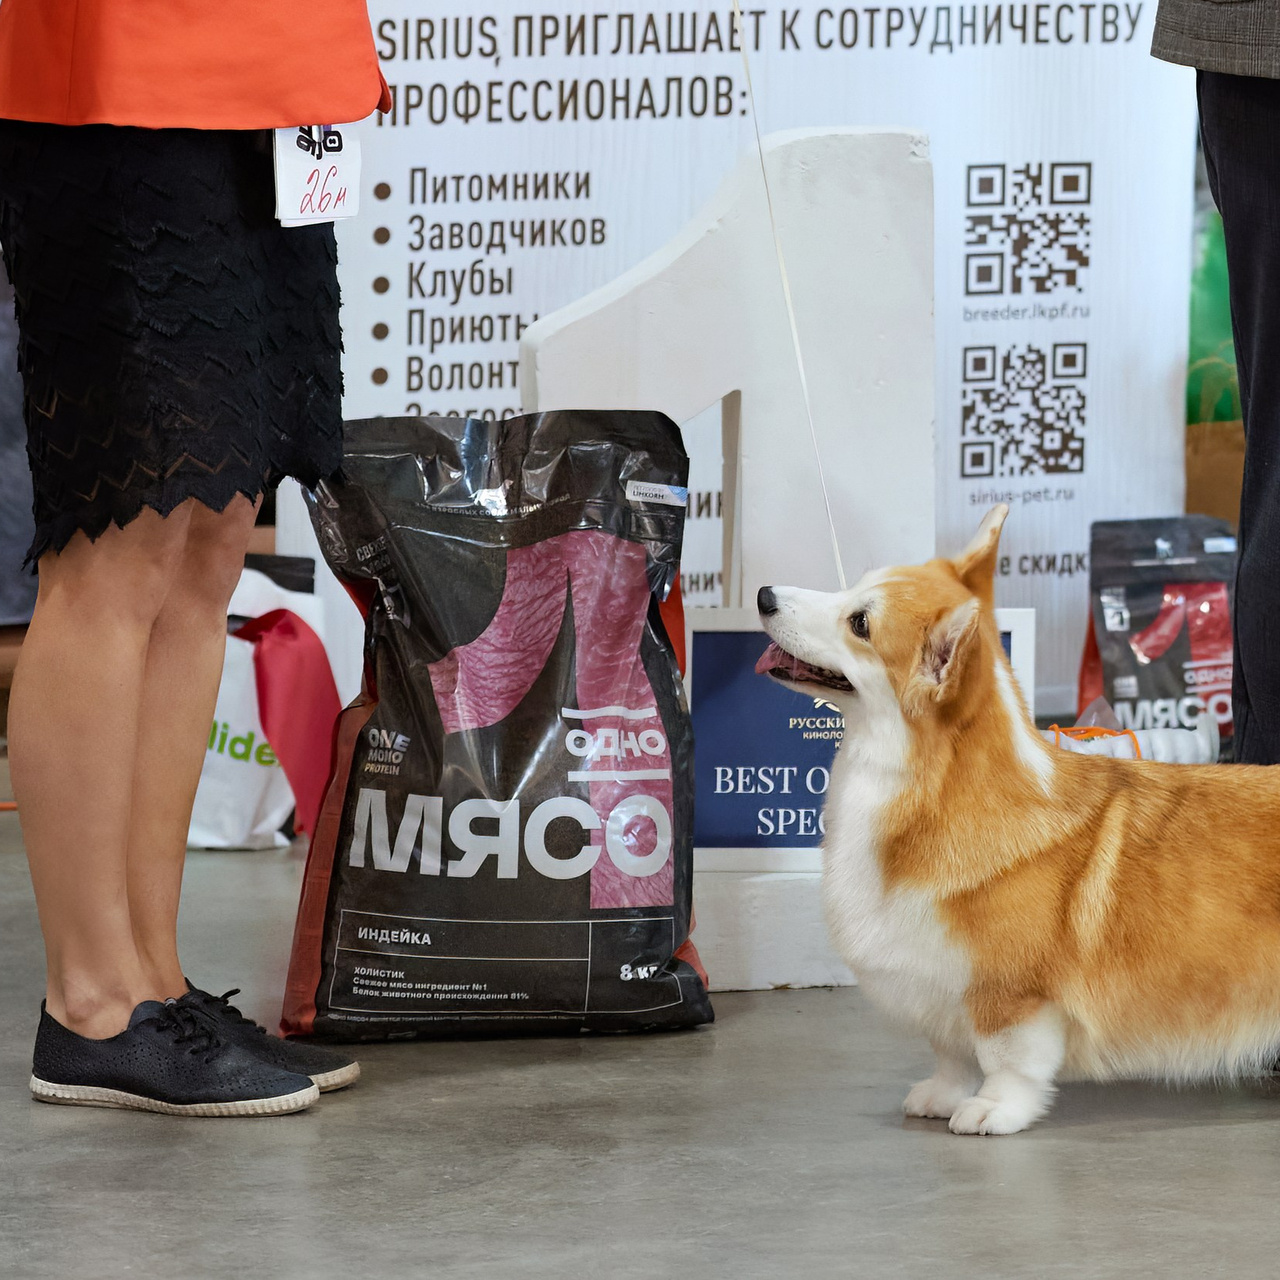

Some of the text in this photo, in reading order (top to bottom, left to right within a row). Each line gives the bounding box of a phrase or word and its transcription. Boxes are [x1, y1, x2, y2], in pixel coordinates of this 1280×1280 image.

[514, 9, 768, 57] ПРИГЛАШАЕТ
[780, 9, 800, 50] К
[815, 2, 1144, 55] СОТРУДНИЧЕСТВУ
[377, 75, 749, 127] ПРОФЕССИОНАЛОВ:
[409, 167, 591, 205] Питомники
[407, 214, 607, 254] Заводчиков
[407, 261, 513, 305] Клубы
[962, 303, 1091, 324] breeder.lkpf.ru
[406, 357, 520, 393] Волонт
[968, 486, 1076, 505] sirius-pet.ru
[1018, 552, 1087, 578] скидк
[789, 716, 846, 729] РУССКИ
[368, 728, 411, 752] ONE
[565, 728, 667, 763] ОДНО
[802, 731, 844, 740] КИНОЛО
[364, 762, 401, 776] PROTEIN
[713, 765, 798, 796] BEST
[349, 787, 672, 881] МЯСО
[358, 926, 432, 946] ИНДЕЙКА
[353, 966, 405, 979] ХОЛИСТИК
[619, 963, 633, 982] 8
[352, 986, 380, 998] Белок
